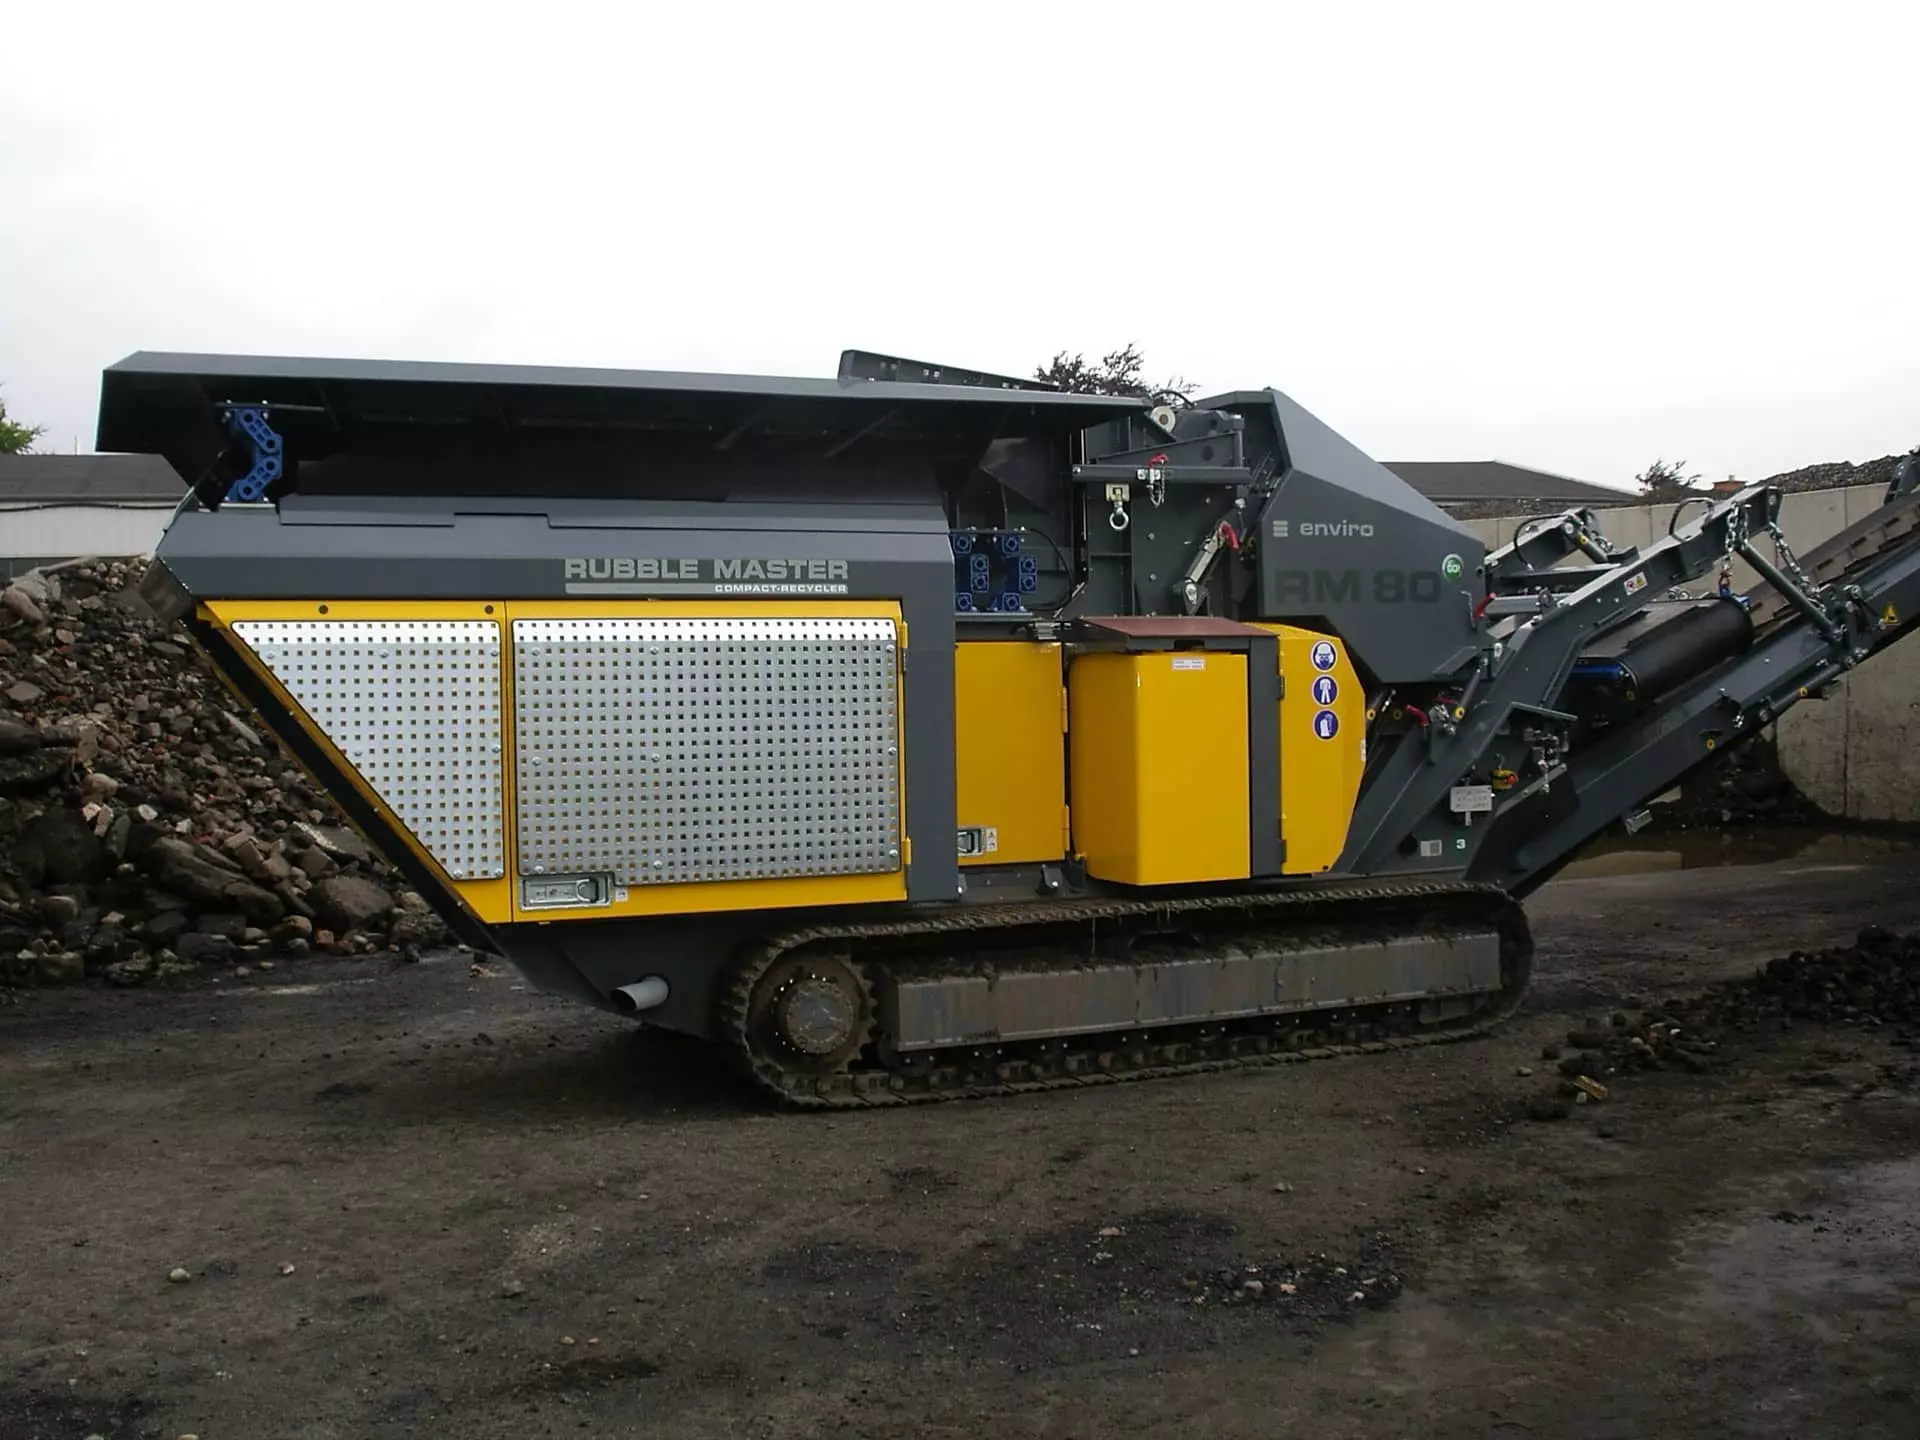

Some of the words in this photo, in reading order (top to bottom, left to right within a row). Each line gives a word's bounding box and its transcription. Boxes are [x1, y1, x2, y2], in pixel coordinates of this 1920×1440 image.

[1299, 519, 1374, 537] enviro
[564, 558, 699, 579] RUBBLE
[713, 559, 849, 580] MASTER
[1275, 569, 1361, 604] RM
[1372, 569, 1442, 604] 80
[1456, 838, 1466, 850] 3
